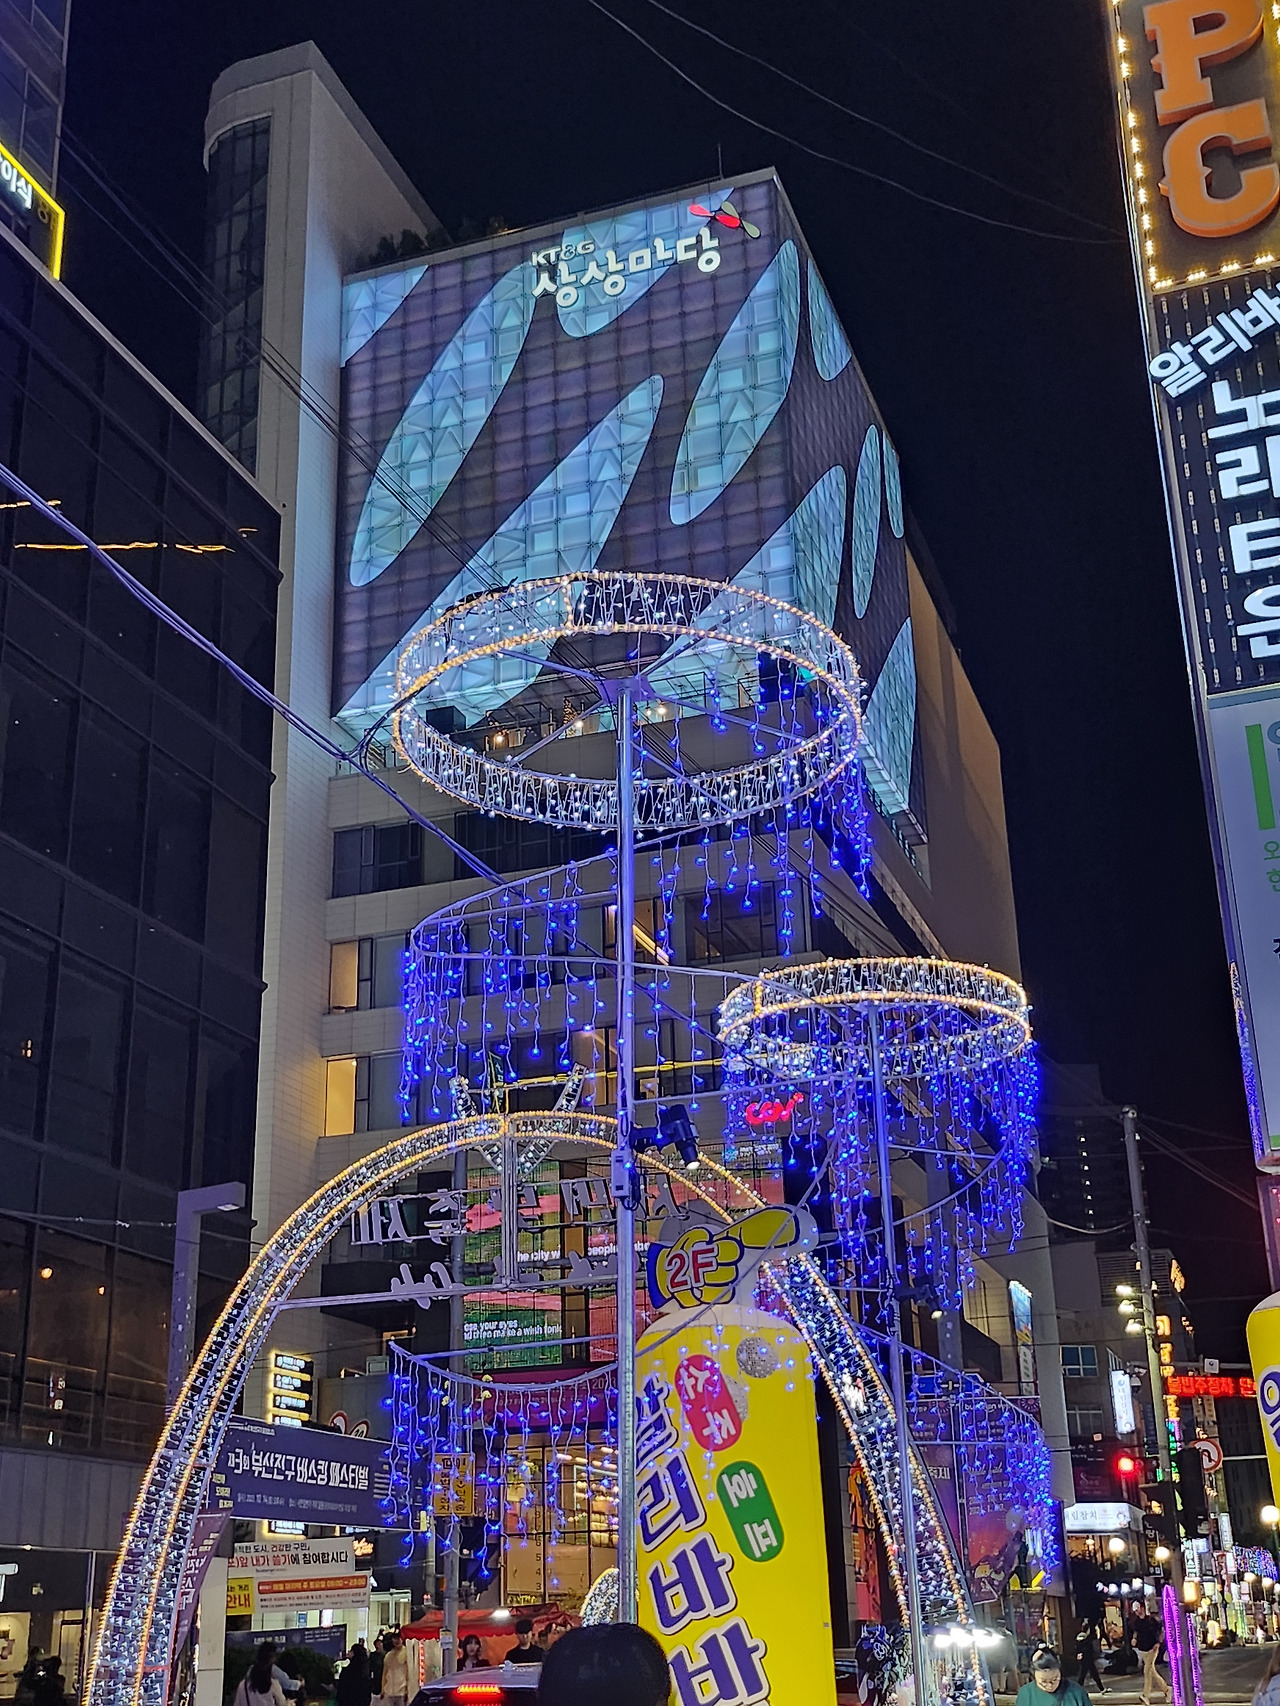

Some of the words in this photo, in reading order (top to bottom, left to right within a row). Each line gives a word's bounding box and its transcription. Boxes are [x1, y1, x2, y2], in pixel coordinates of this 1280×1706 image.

[1143, 0, 1280, 238] PC
[531, 240, 596, 266] KT&G
[531, 227, 722, 308] 상상마당
[1150, 282, 1280, 398] 알리바
[665, 1246, 717, 1290] 2F
[679, 1365, 737, 1445] 소주
[1168, 1376, 1235, 1396] 불법주정차
[251, 1448, 296, 1481] 부산진구
[296, 1456, 329, 1485] 버스킹
[328, 1461, 369, 1490] 페스티벌
[721, 1468, 779, 1558] 호프
[250, 1554, 270, 1567] 내가
[301, 1551, 349, 1564] 참여합시다
[226, 1594, 250, 1608] 안내
